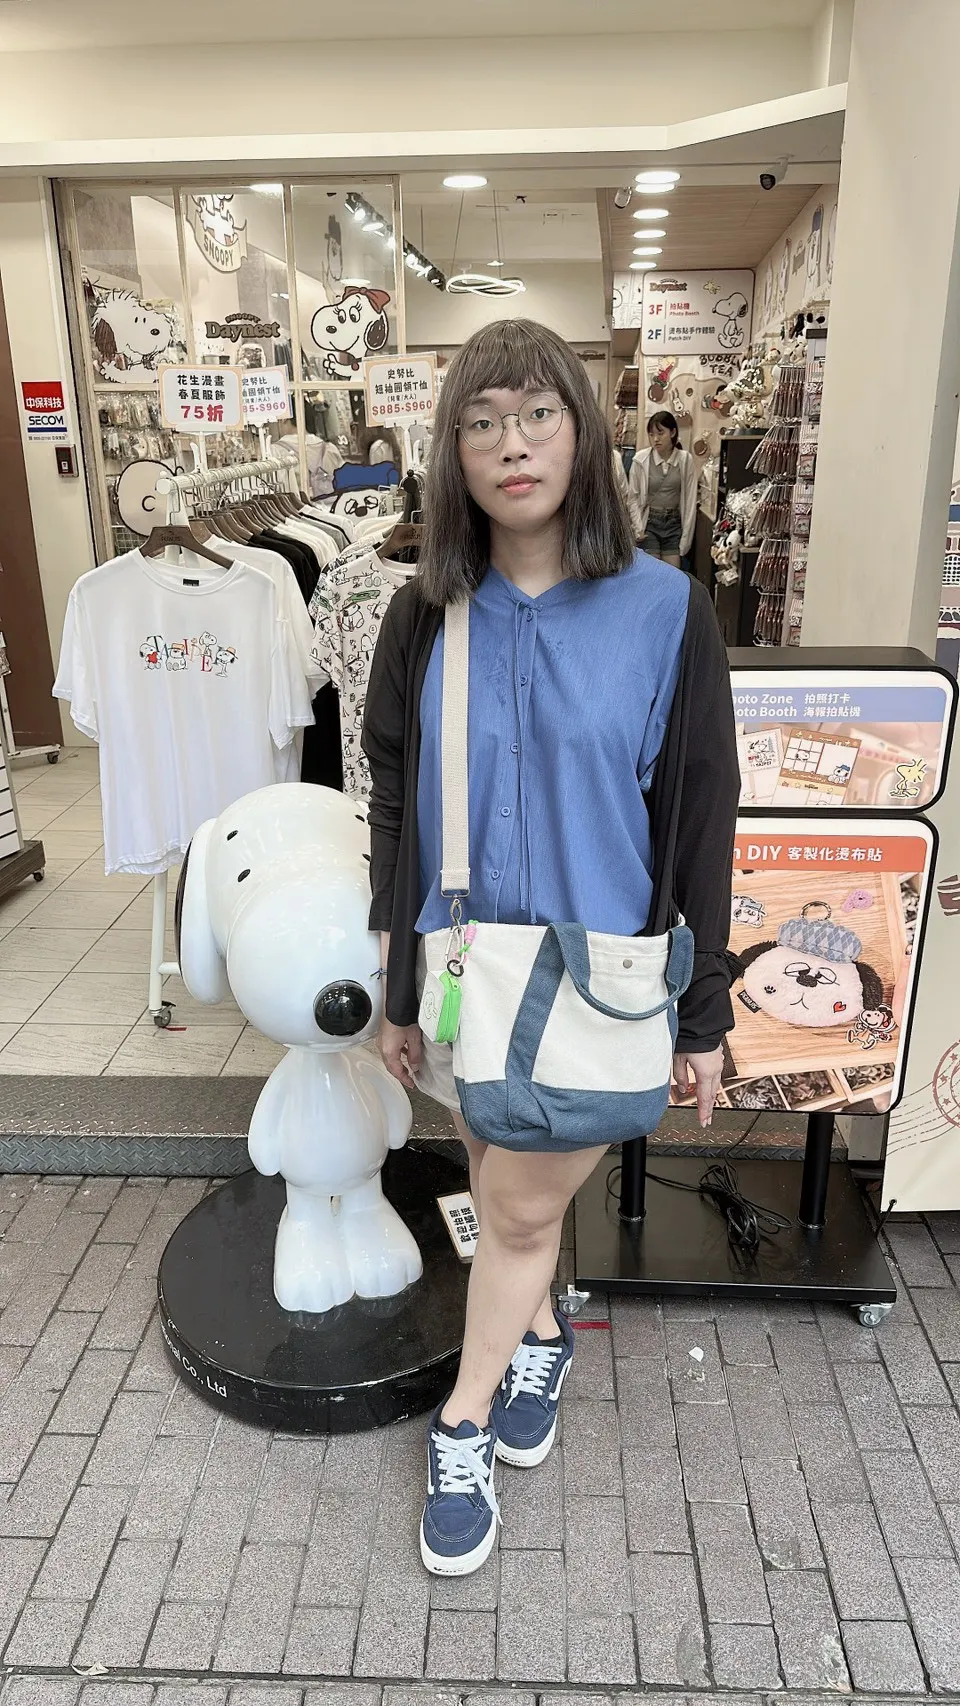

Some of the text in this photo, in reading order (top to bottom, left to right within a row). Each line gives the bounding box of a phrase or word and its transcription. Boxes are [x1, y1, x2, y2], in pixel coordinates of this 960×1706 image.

[203, 234, 234, 267] SNOOPY
[648, 304, 663, 315] 3F
[205, 321, 281, 343] Daynest
[647, 329, 662, 340] 2F
[699, 354, 742, 372] BUBBL
[388, 368, 415, 380] 史努比
[710, 365, 733, 378] TEA
[177, 374, 225, 387] 花生漫畫
[178, 389, 226, 401] 春夏服飾
[242, 385, 281, 398] 圓領T恤
[26, 397, 63, 409] 中保科技
[180, 404, 224, 422] 75折
[28, 415, 65, 426] SECOM
[732, 693, 851, 704] oto Zone 拍照打卡
[736, 706, 861, 717] oto Booth 海報拍貼機
[747, 844, 783, 861] DIY
[787, 846, 883, 862] 客製化燙布貼
[206, 1375, 228, 1398] Ltd
